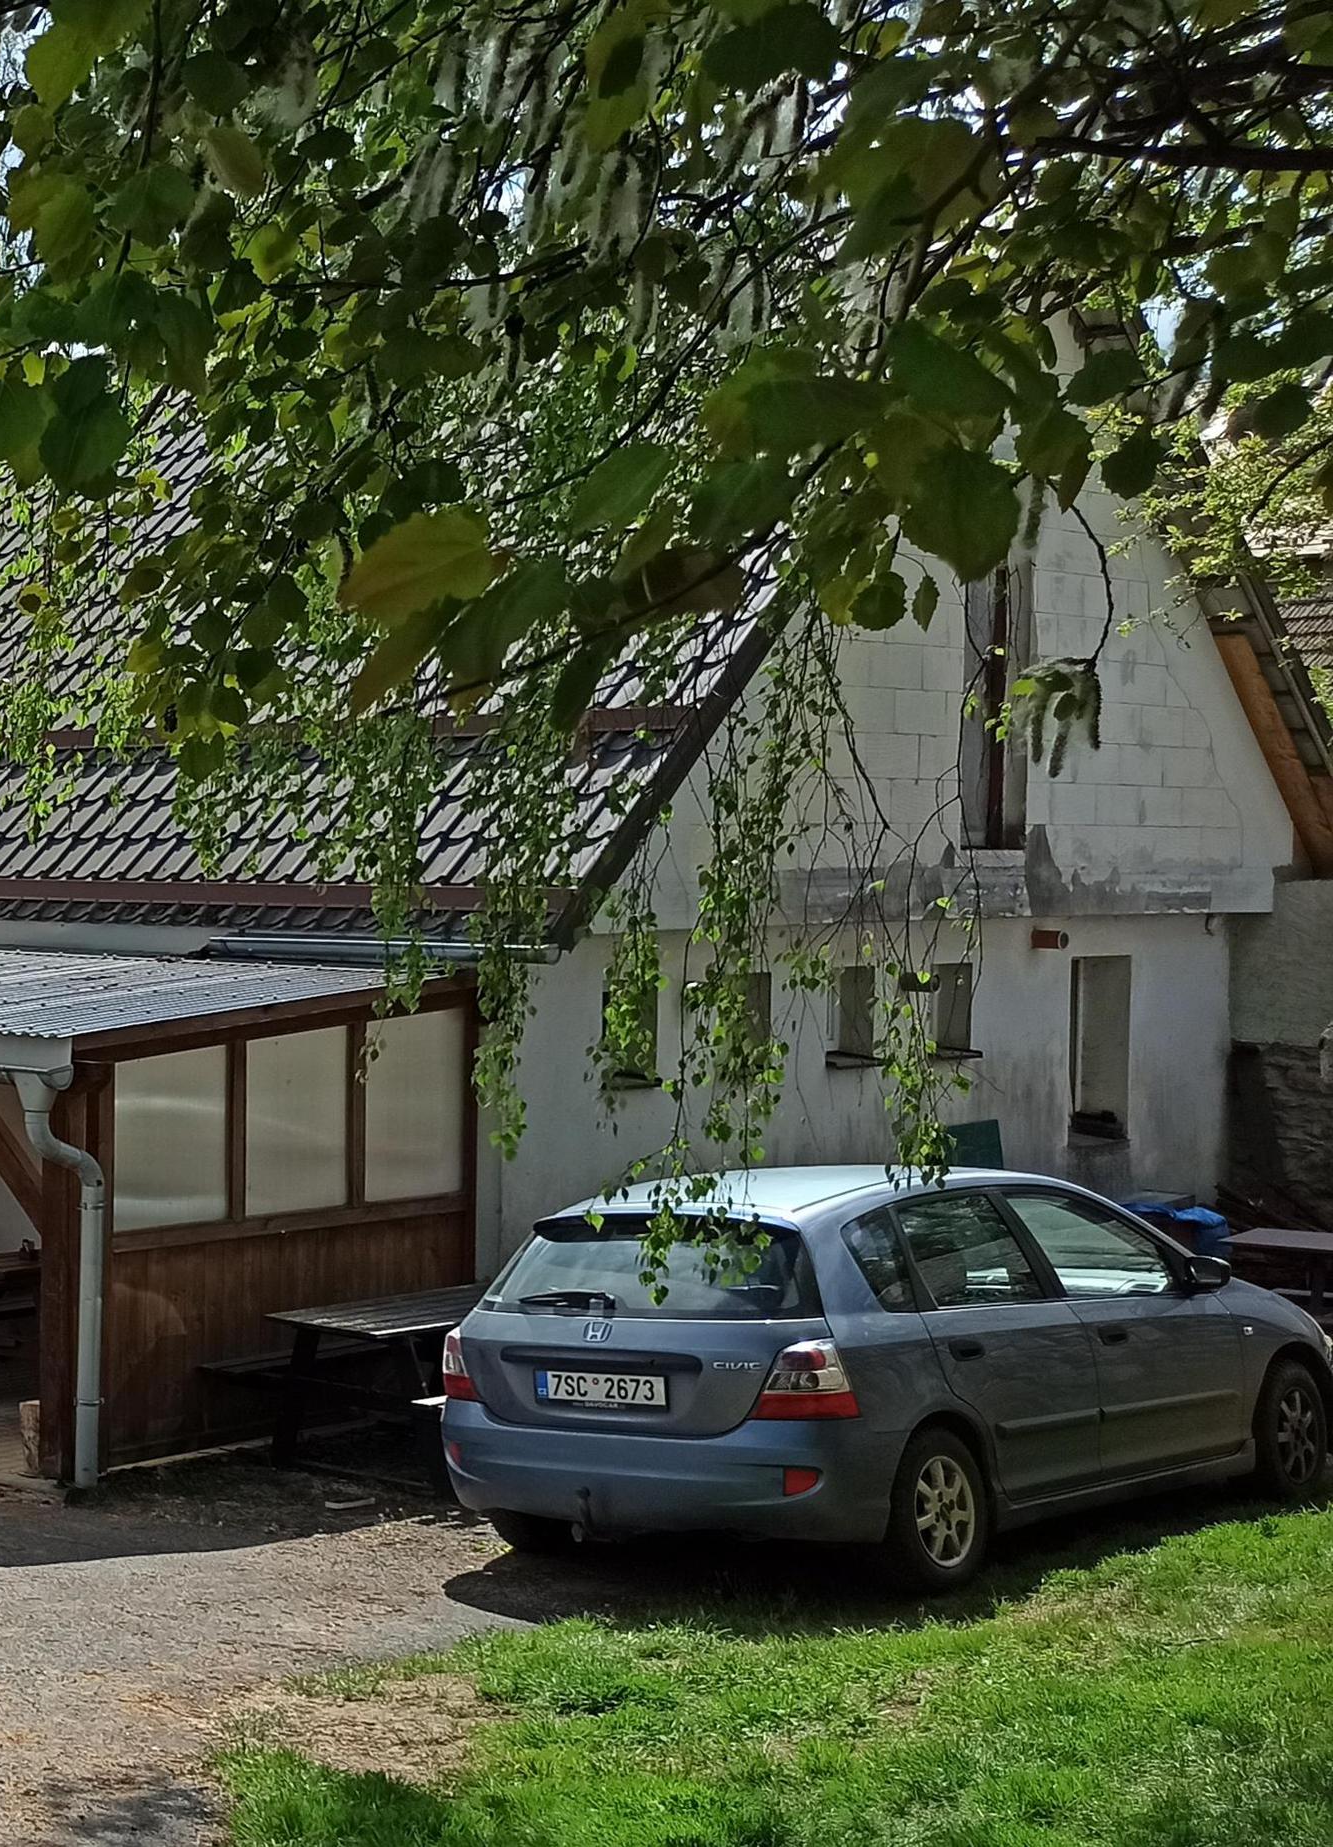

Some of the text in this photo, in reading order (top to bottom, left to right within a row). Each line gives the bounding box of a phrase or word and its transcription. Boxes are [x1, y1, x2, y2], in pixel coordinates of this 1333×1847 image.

[713, 1361, 761, 1370] CIVIC
[551, 1374, 654, 1401] 7SC 2673
